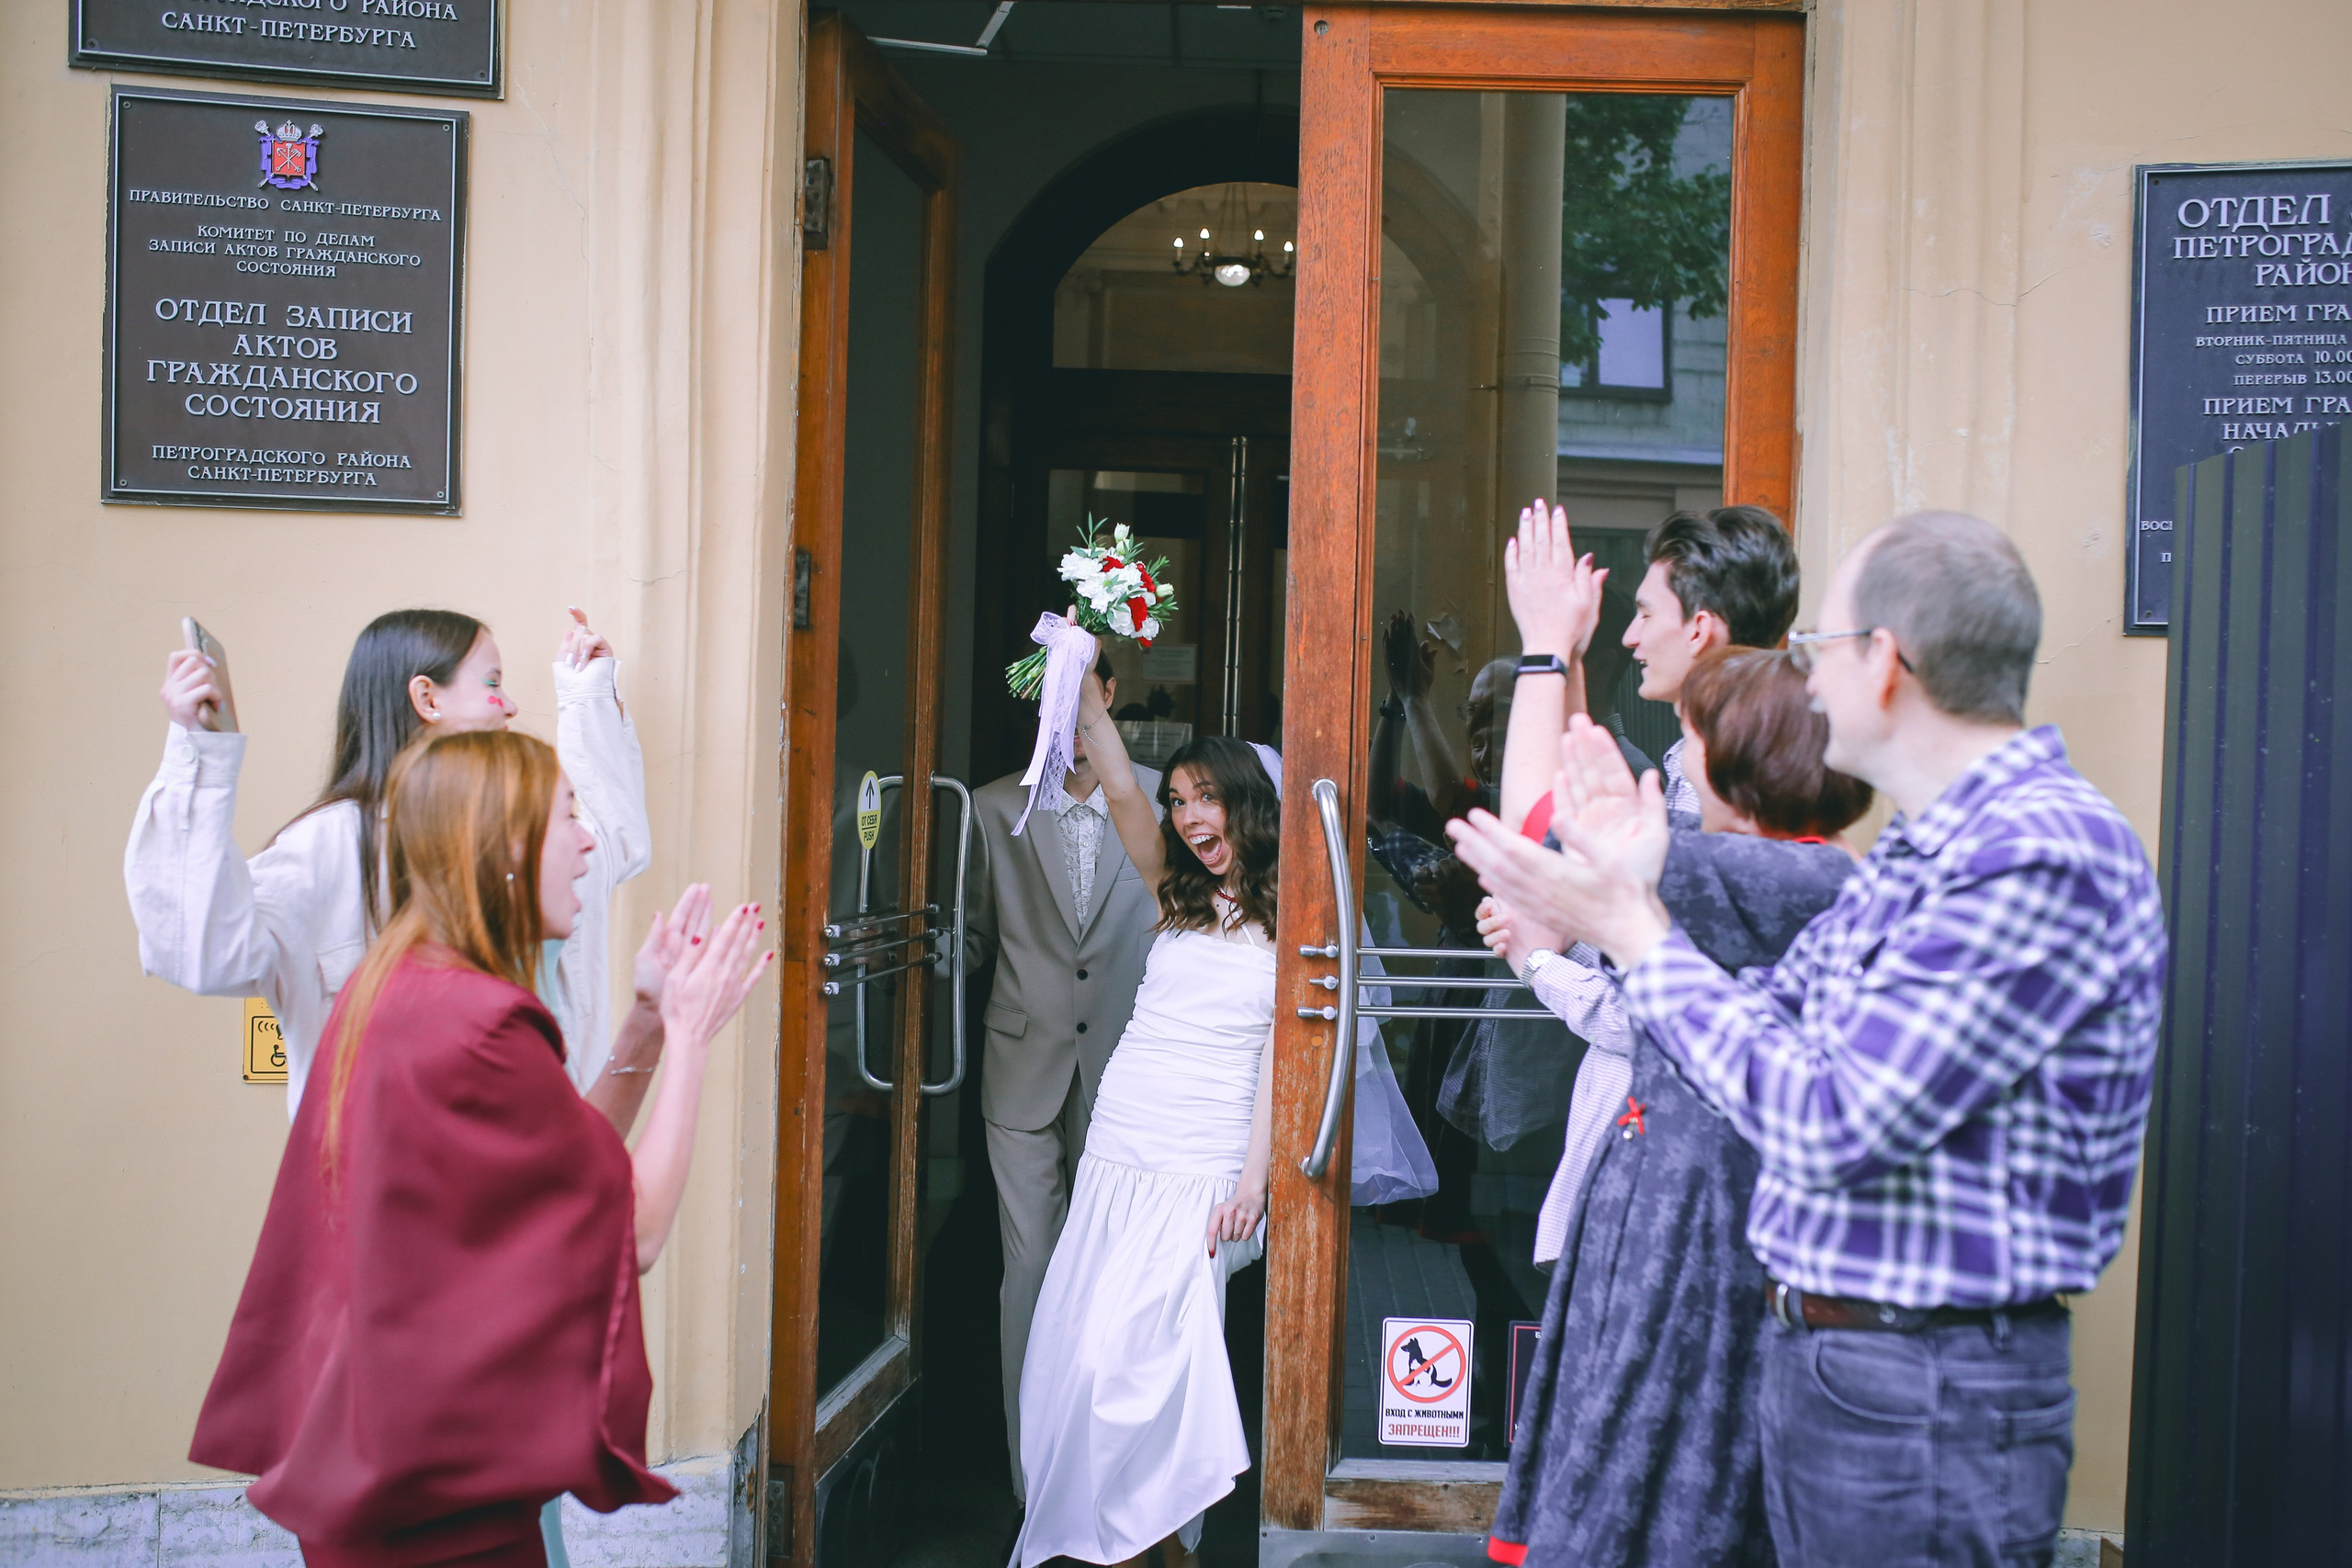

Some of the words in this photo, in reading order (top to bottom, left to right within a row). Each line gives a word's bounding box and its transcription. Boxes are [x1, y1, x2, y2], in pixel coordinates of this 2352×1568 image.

[162, 12, 416, 49] САНКТ-ПЕТЕРБУРГА
[129, 189, 270, 210] ПРАВИТЕЛЬСТВО
[280, 199, 442, 221] САНКТ-ПЕТЕРБУРГА
[2177, 194, 2331, 233] ОТДЕЛ
[198, 225, 276, 242] КОМИТЕТ
[284, 231, 307, 243] ПО
[315, 232, 375, 248] ДЕЛАМ
[149, 239, 217, 255] ЗАПИСИ
[224, 243, 278, 258] АКТОВ
[286, 247, 422, 267] ГРАЖДАНСКОГО
[236, 260, 336, 277] СОСТОЯНИЯ
[155, 298, 266, 328] ОТДЕЛ
[286, 305, 413, 333] ЗАПИСИ
[2206, 305, 2298, 323] ПРИЕМ
[2306, 304, 2352, 321] ГРА
[232, 334, 338, 360] АКТОВ
[2195, 334, 2347, 347] ВТОРНИК-ПЯТНИЦА
[2235, 354, 2304, 365] СУББОТА
[147, 360, 418, 395] ГРАЖДАНСКОГО
[2233, 374, 2307, 386] ПЕРЕРЫВ
[185, 393, 380, 423] СОСТОЯНИЯ
[2203, 397, 2294, 415] ПРИЕМ
[2305, 396, 2352, 413] ГРА
[152, 446, 326, 466] ПЕТРОГРАДСКОГО
[336, 450, 412, 468] РАЙОНА
[187, 466, 378, 486] САНКТ-ПЕТЕРБУРГА
[1385, 1408, 1406, 1418] ВХОД
[1415, 1409, 1464, 1419] ЖИВОТНЫМИ
[1388, 1424, 1460, 1438] ЗАПРЕЩЕН!!!
